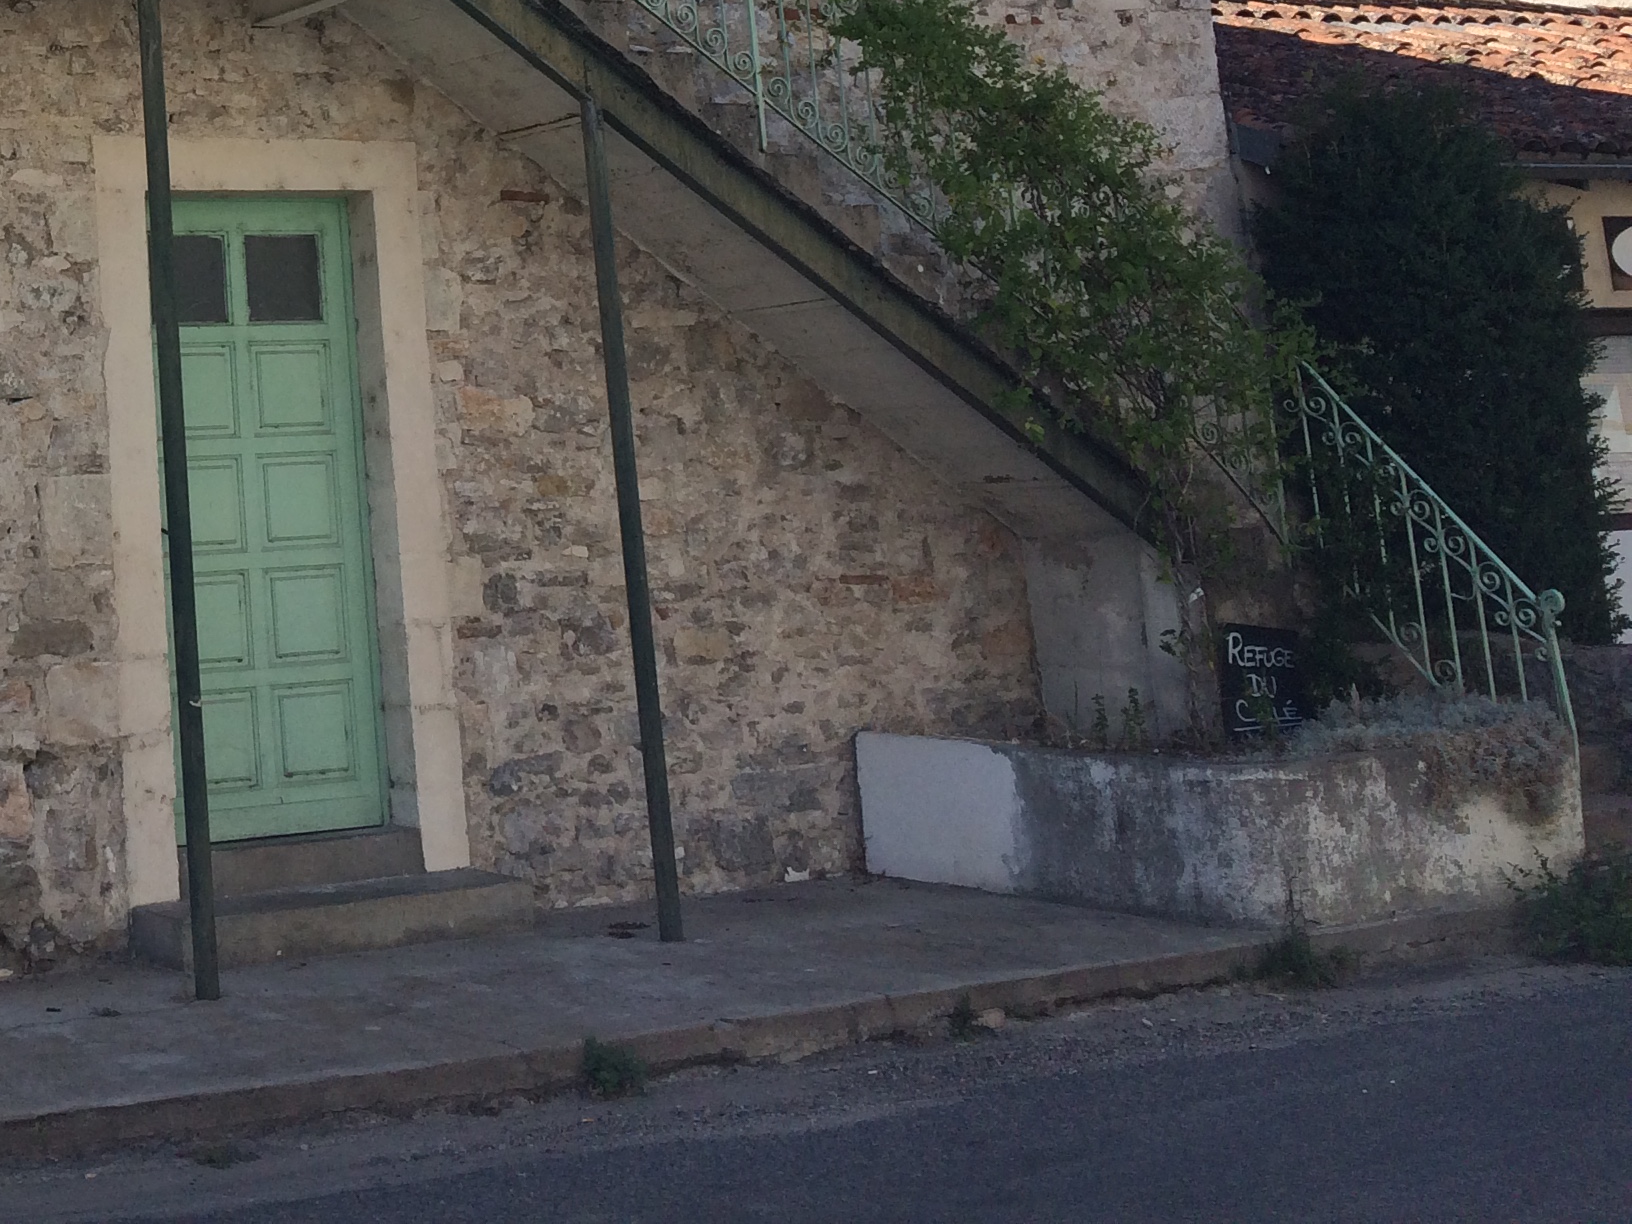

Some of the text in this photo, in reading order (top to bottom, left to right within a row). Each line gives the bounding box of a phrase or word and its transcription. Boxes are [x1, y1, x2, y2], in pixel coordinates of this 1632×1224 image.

[1226, 632, 1295, 668] REFUGE
[1246, 674, 1277, 698] DU
[1235, 699, 1303, 722] CLÉ
